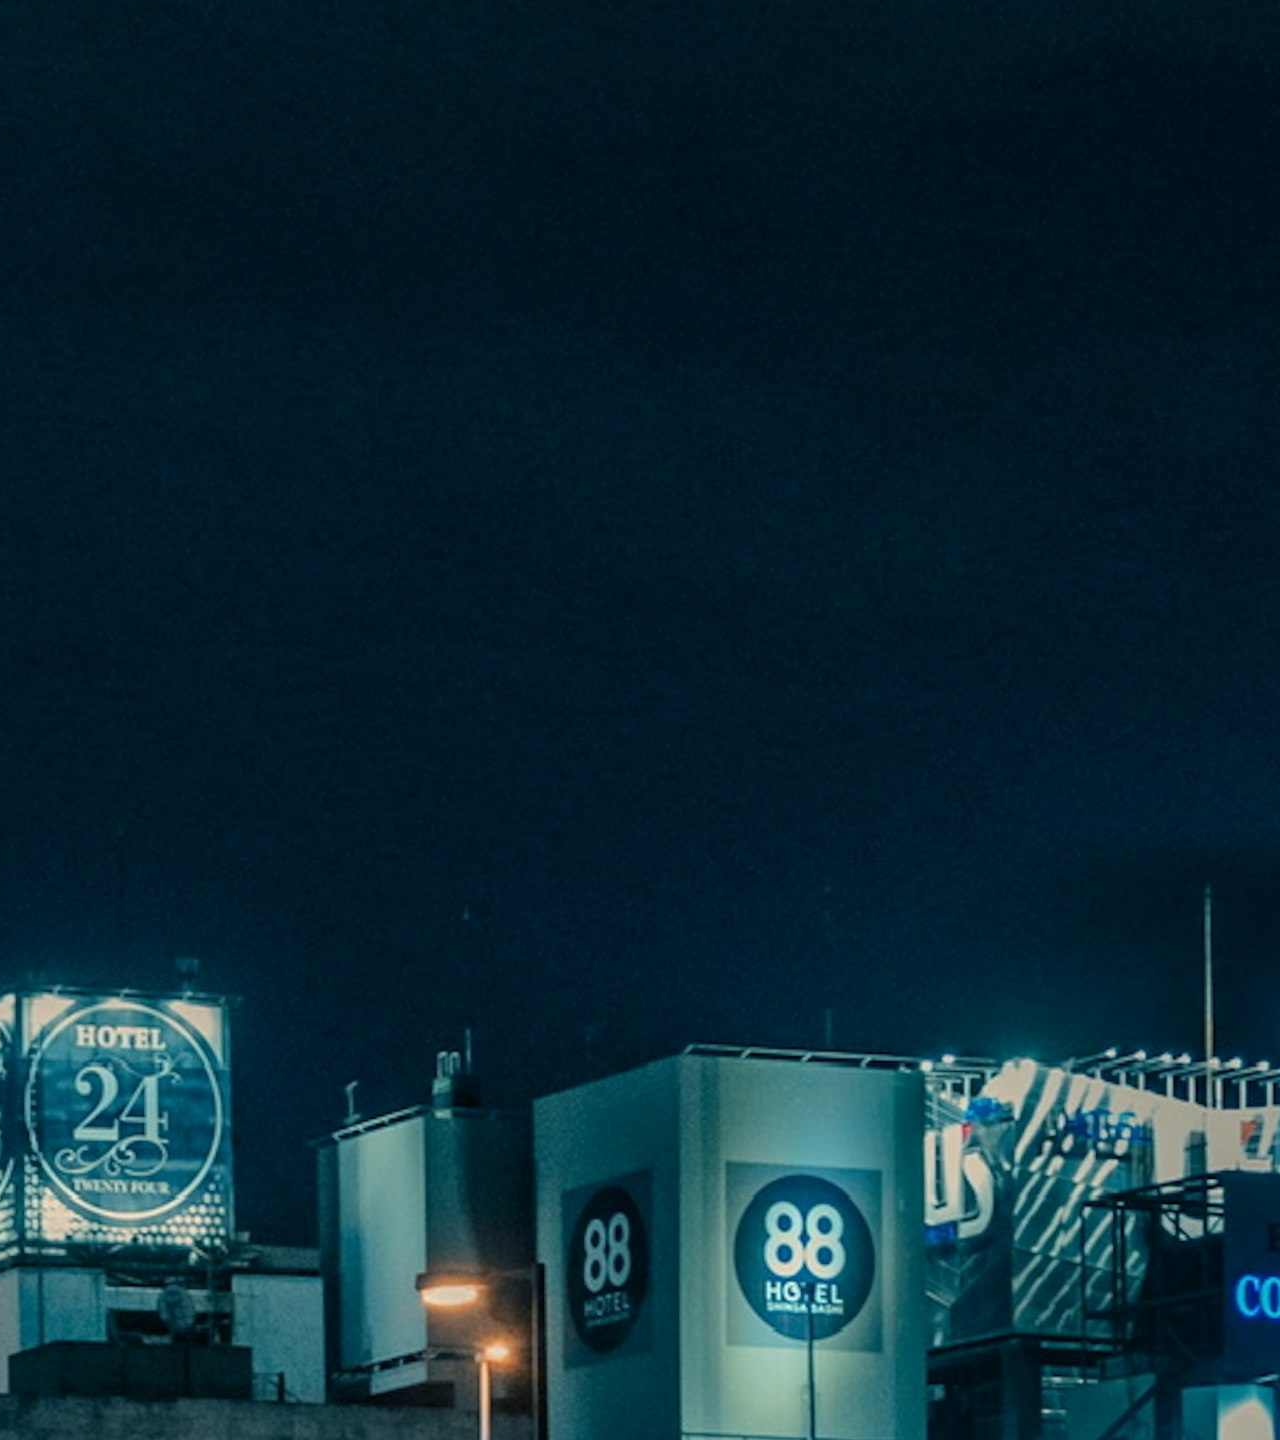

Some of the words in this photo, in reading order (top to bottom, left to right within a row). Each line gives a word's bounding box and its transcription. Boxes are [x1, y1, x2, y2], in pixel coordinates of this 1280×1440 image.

[75, 1024, 166, 1051] HOTEL
[72, 1065, 169, 1144] 24
[583, 1211, 632, 1293] 88
[764, 1201, 846, 1279] 88
[766, 1281, 844, 1304] HOEL
